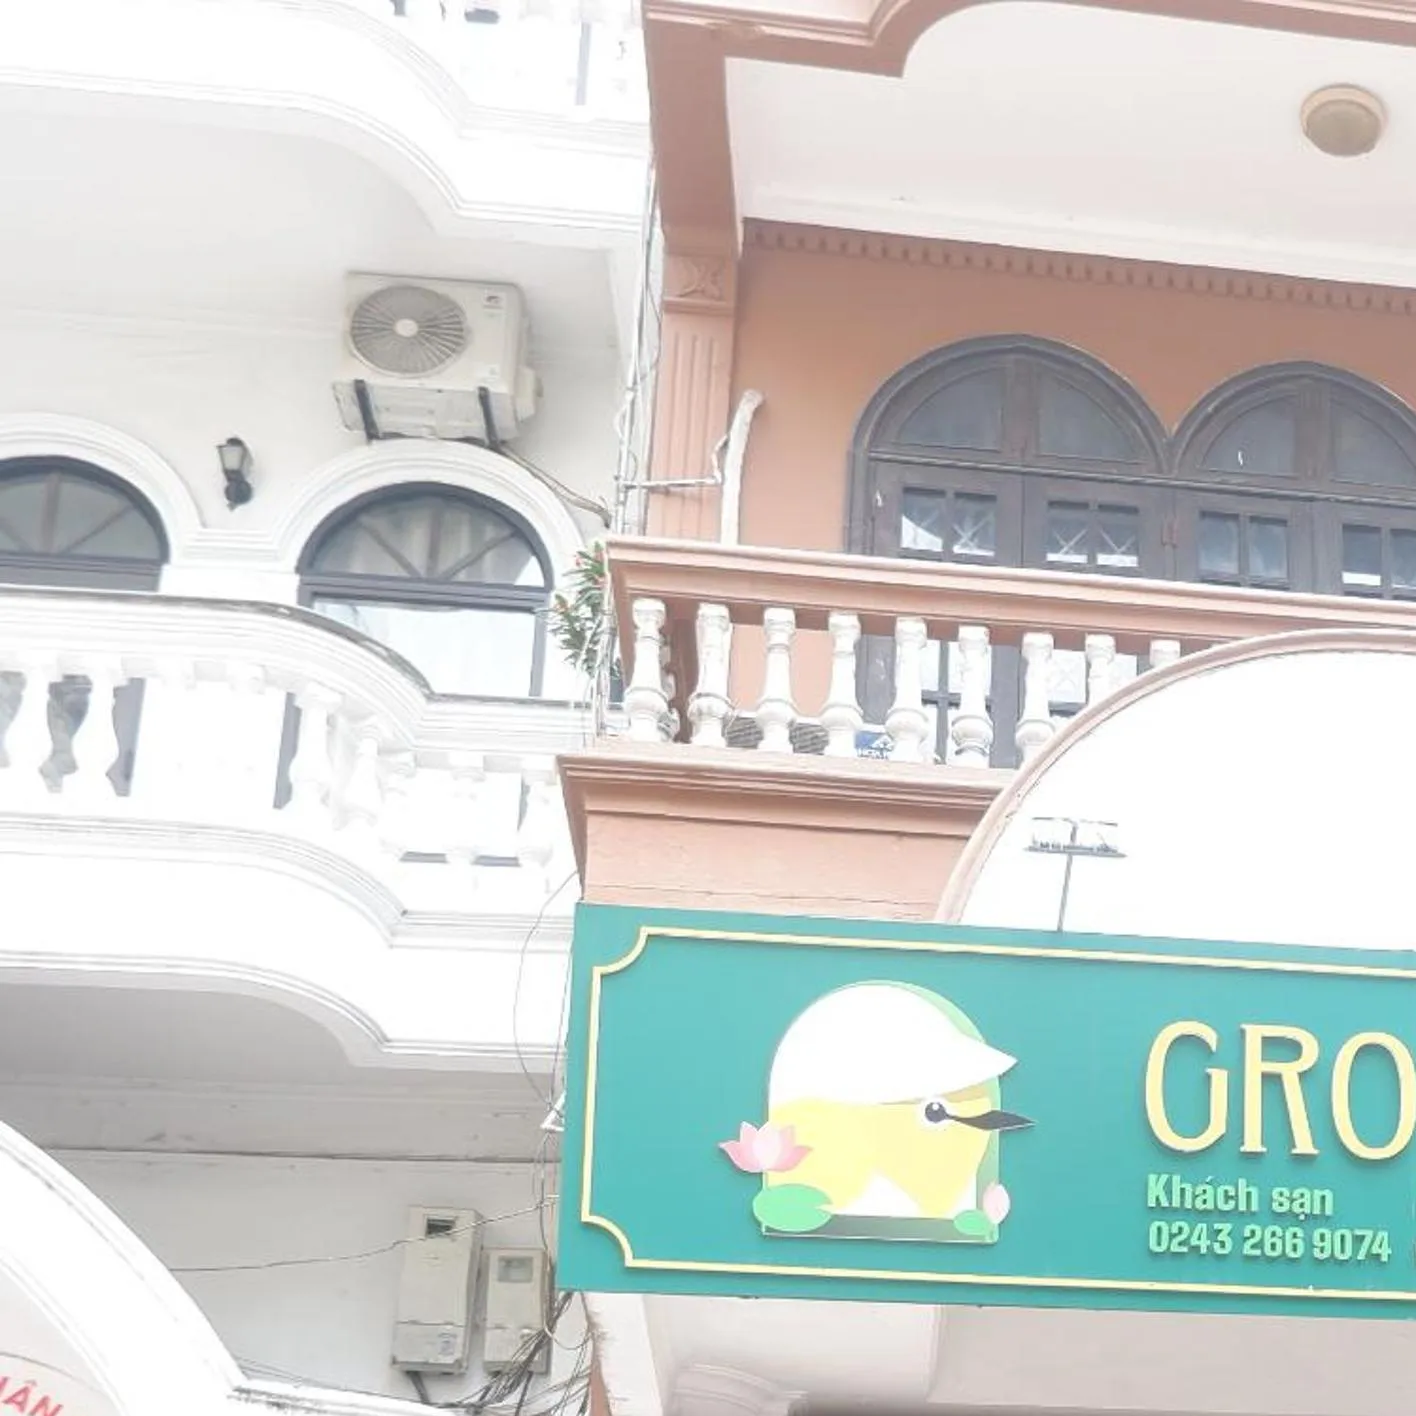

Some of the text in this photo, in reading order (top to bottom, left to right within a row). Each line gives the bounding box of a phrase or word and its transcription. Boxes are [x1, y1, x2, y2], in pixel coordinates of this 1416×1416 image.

[1147, 1174, 1334, 1220] Khách sạn
[1149, 1221, 1391, 1263] 0243 266 9074
